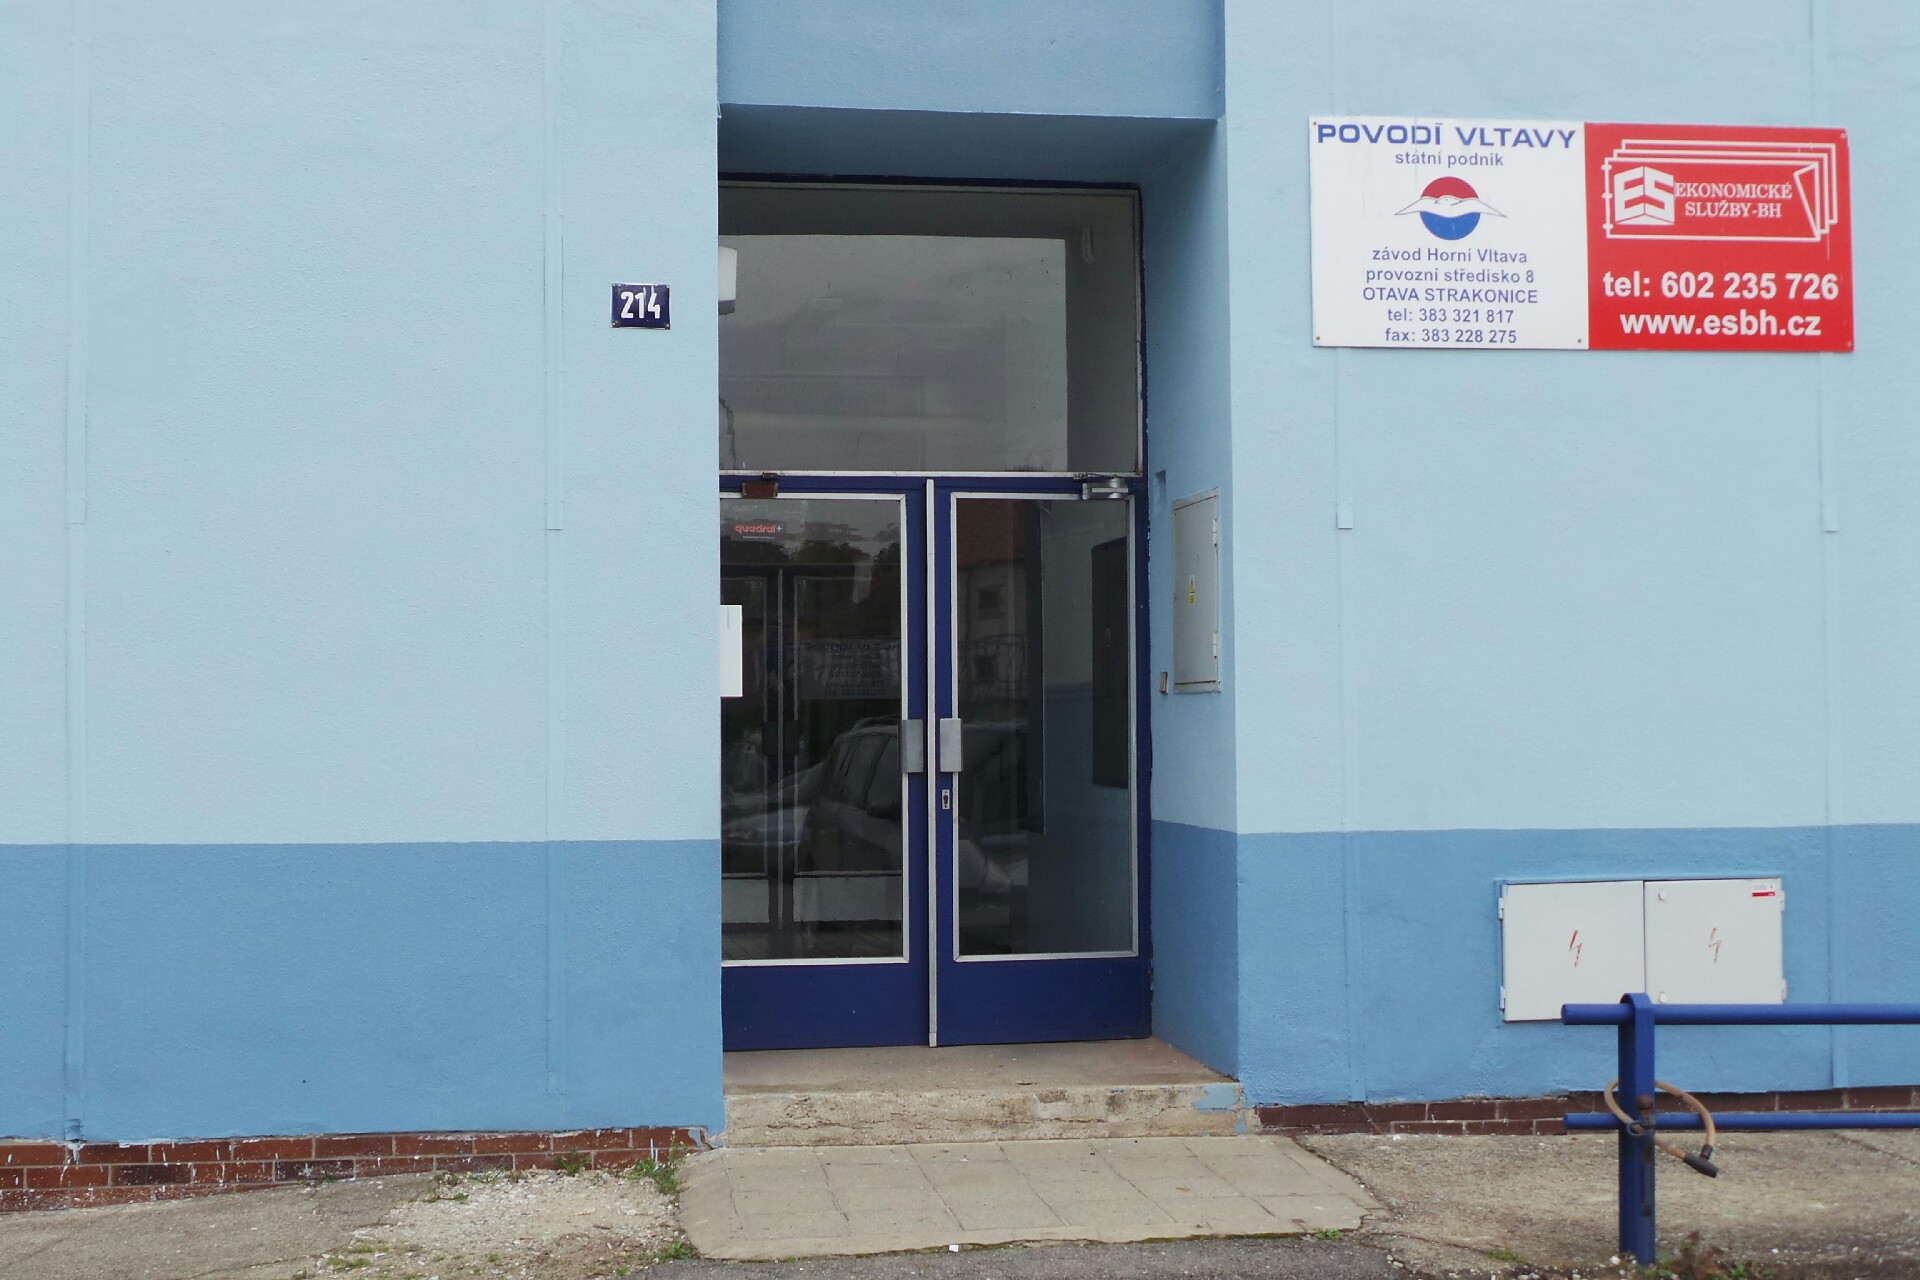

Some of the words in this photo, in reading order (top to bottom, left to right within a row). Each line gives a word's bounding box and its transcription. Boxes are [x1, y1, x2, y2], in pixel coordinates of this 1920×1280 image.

[1318, 122, 1443, 145] POVODÍ
[1455, 126, 1576, 149] VLTAVY
[1395, 150, 1442, 165] státní
[1447, 152, 1504, 169] podnik
[1675, 181, 1793, 199] EKONOMICKÉ
[1372, 246, 1421, 261] závod
[1427, 247, 1471, 262] Horní
[1477, 248, 1527, 263] Vltava
[1366, 267, 1439, 284] provozní
[1444, 268, 1520, 283] středisko
[1526, 269, 1534, 284] 8
[1602, 270, 1650, 297] tel:
[1661, 271, 1714, 299] 602
[1723, 272, 1777, 299] 235
[1785, 272, 1839, 300] 726
[1363, 287, 1419, 301] OTAVA
[1425, 288, 1538, 304] STRAKONICE
[620, 291, 661, 319] 214
[1387, 307, 1413, 322] tel:
[1419, 308, 1447, 322] 383
[1453, 308, 1479, 323] 321
[1486, 309, 1514, 324] 817
[1620, 309, 1821, 336] www.esbh.cz
[1385, 327, 1415, 342] fax:
[1421, 328, 1450, 343] 383
[1455, 329, 1483, 343] 228
[1489, 329, 1517, 344] 275
